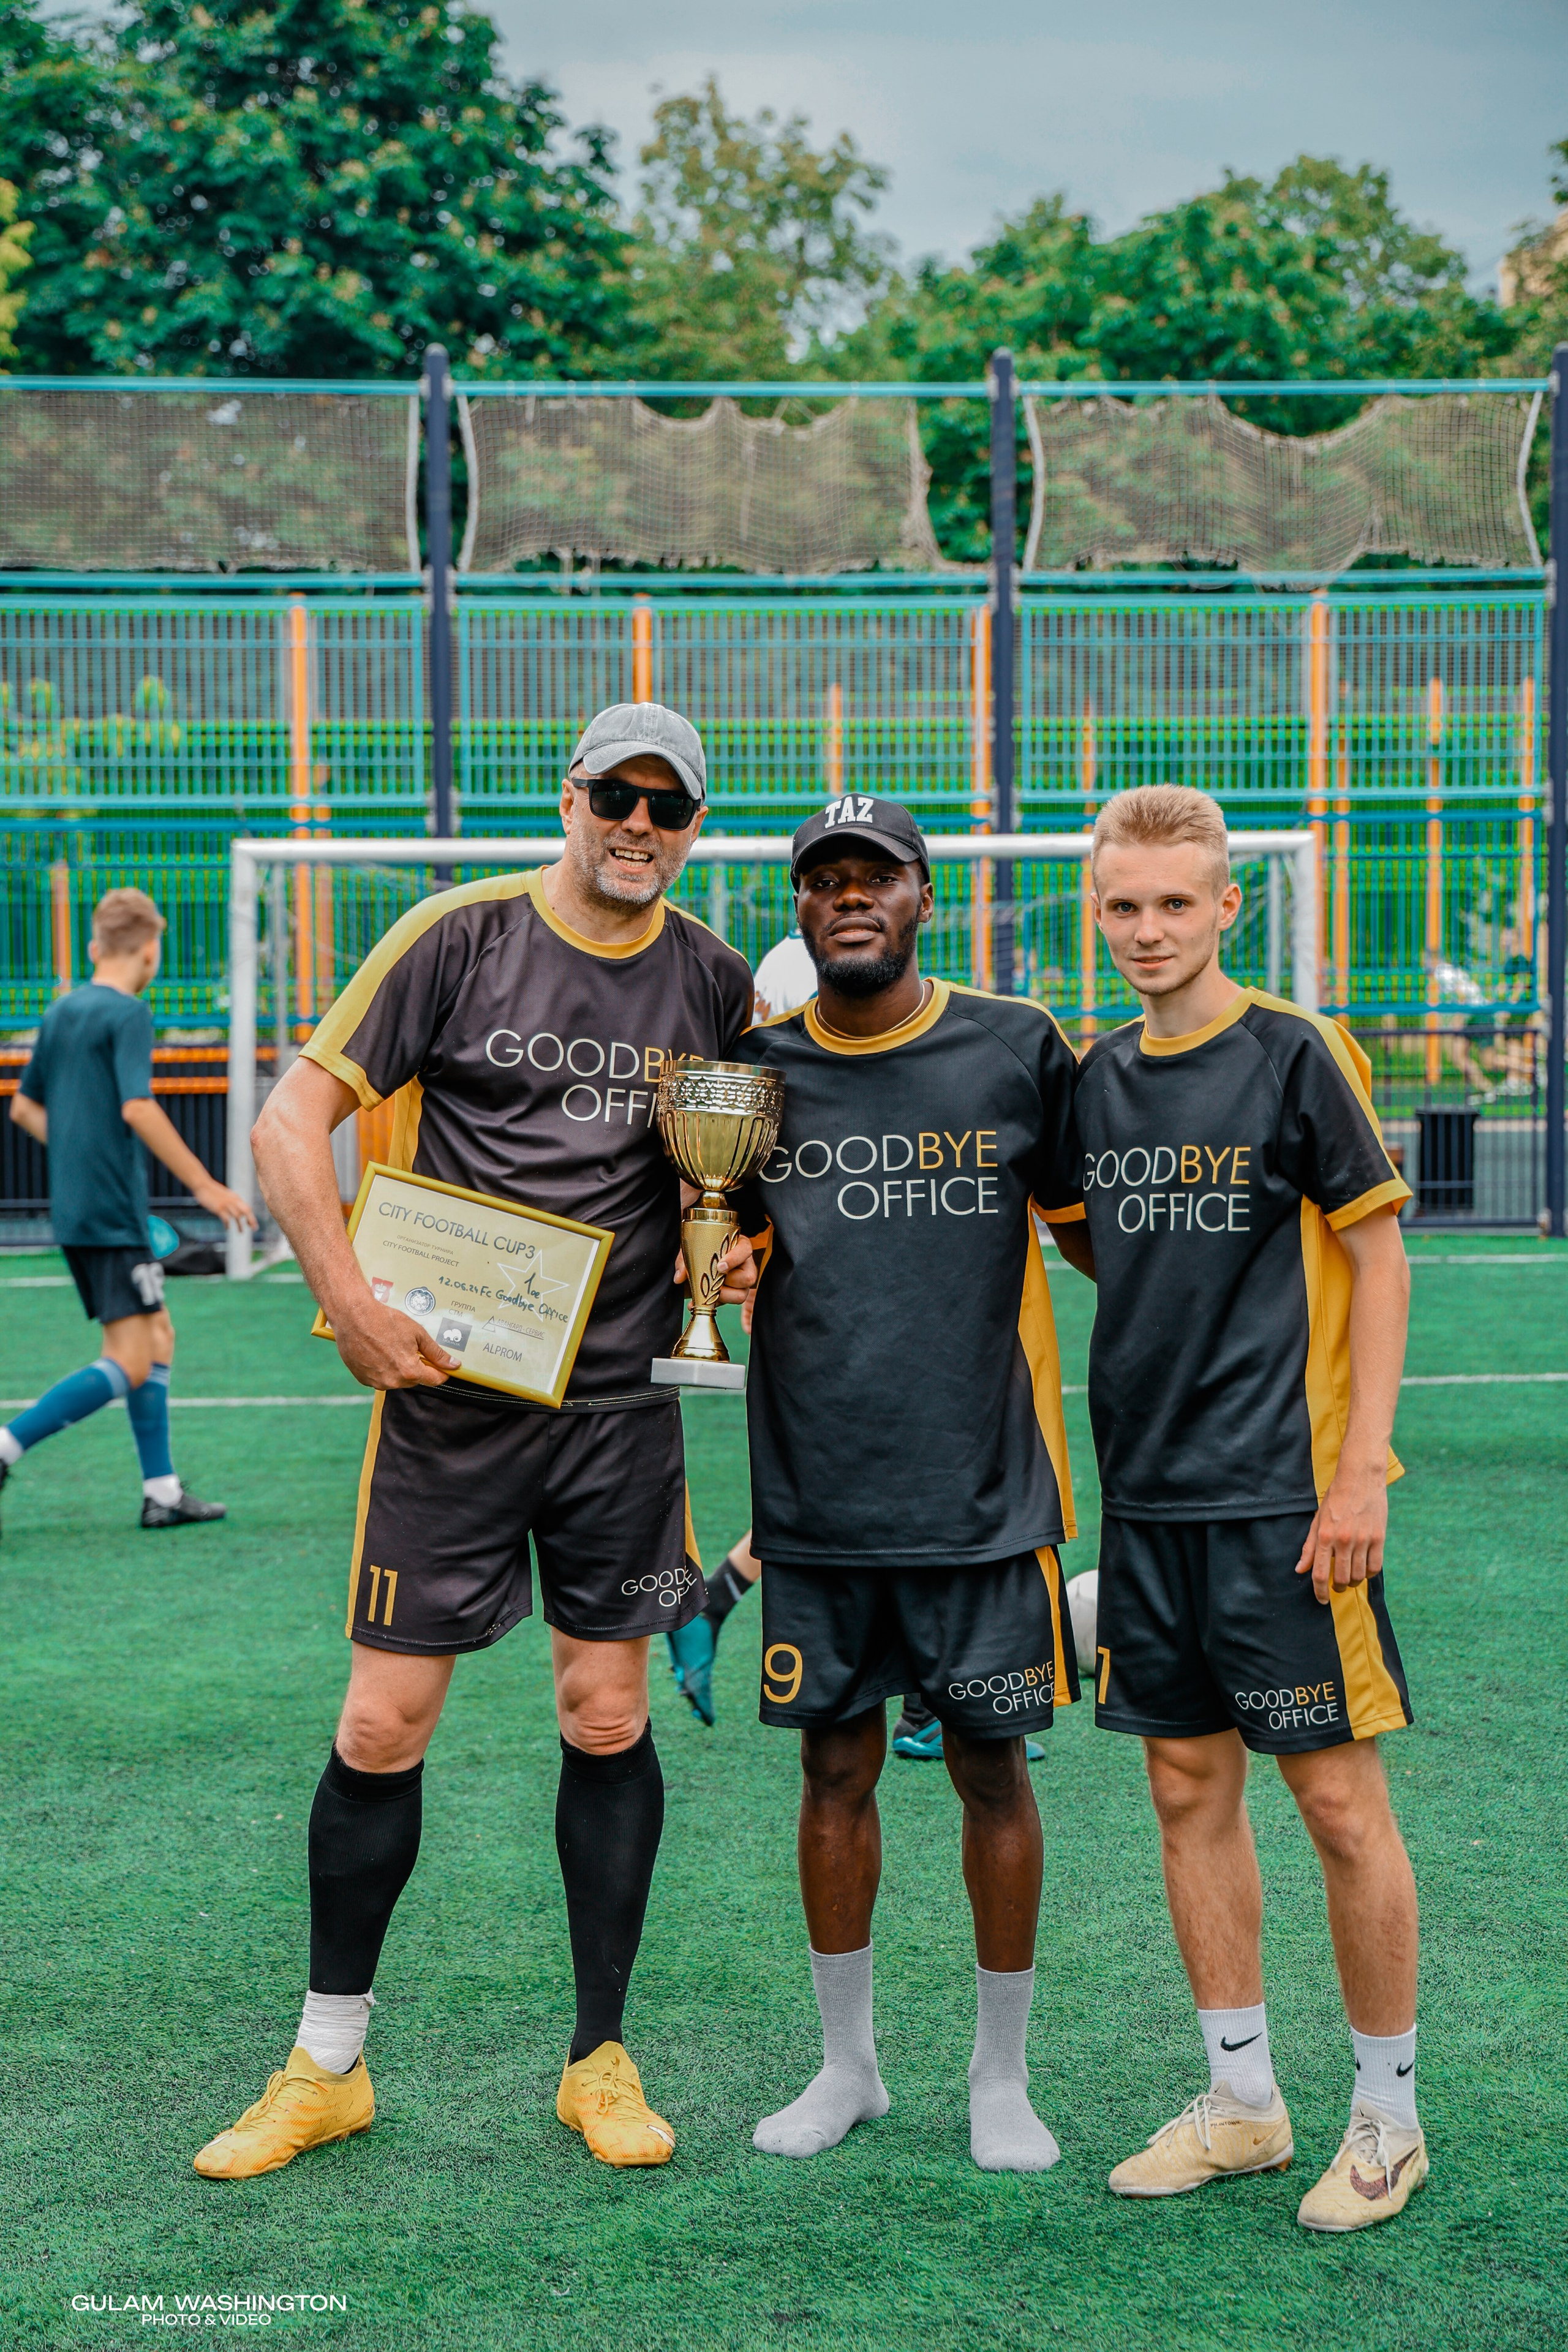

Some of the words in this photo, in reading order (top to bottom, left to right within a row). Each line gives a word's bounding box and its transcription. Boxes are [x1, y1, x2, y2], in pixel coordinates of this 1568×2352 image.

[825, 796, 874, 828] TAZ
[486, 1029, 704, 1083] GOODB
[562, 1084, 657, 1128] OFFI
[758, 1131, 998, 1183] GOODBYE
[1083, 1145, 1251, 1191] GOODBYE
[837, 1176, 998, 1220] OFFICE
[1118, 1193, 1251, 1234] OFFICE
[379, 1202, 412, 1222] CITY
[413, 1212, 488, 1246] FOOTBALL
[383, 1240, 398, 1249] CITY
[398, 1245, 430, 1259] FOOTBALL
[431, 1254, 459, 1267] PROJECT
[397, 1235, 431, 1248] ОРГАНИЗАТОР
[431, 1245, 454, 1255] ТУРНИРА
[439, 1276, 478, 1294] 12.06.24
[496, 1289, 535, 1311] Goodbye
[539, 1303, 568, 1323] Office
[448, 1308, 463, 1317] СТМ
[451, 1300, 475, 1313] ГРУППА
[483, 1343, 522, 1362] ALPROM
[368, 1564, 398, 1626] 11
[763, 1643, 804, 1703] 9
[949, 1660, 1054, 1700] GOODBYE
[992, 1681, 1055, 1714] OFFICE
[1235, 1681, 1336, 1710] GOODBYE
[1268, 1702, 1340, 1730] OFFICE
